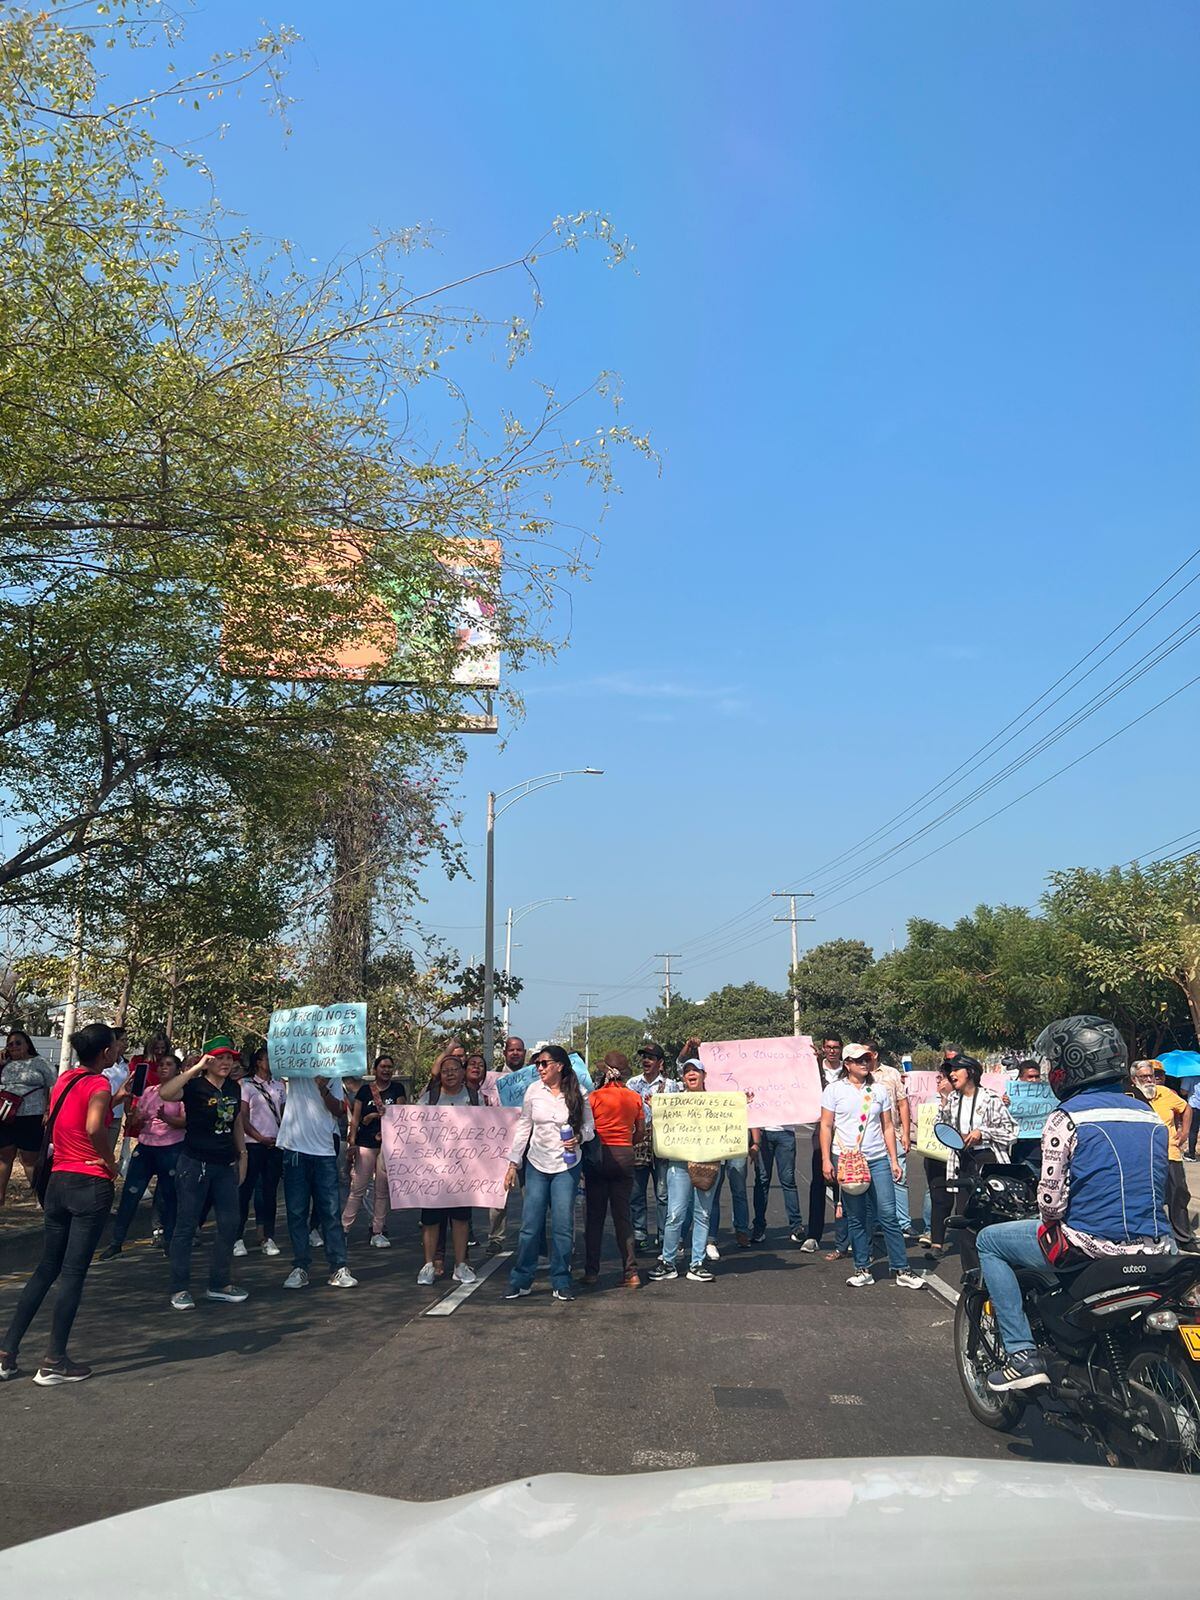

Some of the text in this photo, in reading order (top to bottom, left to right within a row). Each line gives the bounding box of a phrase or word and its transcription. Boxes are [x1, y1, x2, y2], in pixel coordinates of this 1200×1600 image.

[287, 1010, 323, 1022] DERECHO
[325, 1010, 342, 1021] NO
[343, 1008, 357, 1020] ES
[273, 1028, 291, 1040] ALGO
[293, 1025, 310, 1037] QUE
[274, 1042, 356, 1056] ES ALGO QUE NADIE
[709, 1045, 731, 1062] Por
[738, 1043, 748, 1059] la
[274, 1056, 337, 1070] TE PUEDE QUITAR
[1009, 1083, 1021, 1097] LA
[657, 1097, 668, 1107] LA
[708, 1098, 720, 1107] ES
[722, 1098, 736, 1107] EL
[662, 1109, 683, 1121] ARMA
[393, 1124, 508, 1144] RESTABLEZCA
[662, 1122, 676, 1135] QUE
[663, 1135, 702, 1147] CAMBIAR
[704, 1136, 715, 1146] EL
[389, 1148, 408, 1161] EL
[412, 1147, 477, 1160] SERVICIO
[490, 1146, 510, 1160] DE
[389, 1178, 444, 1199] PADRES
[1122, 1263, 1147, 1274] auteco
